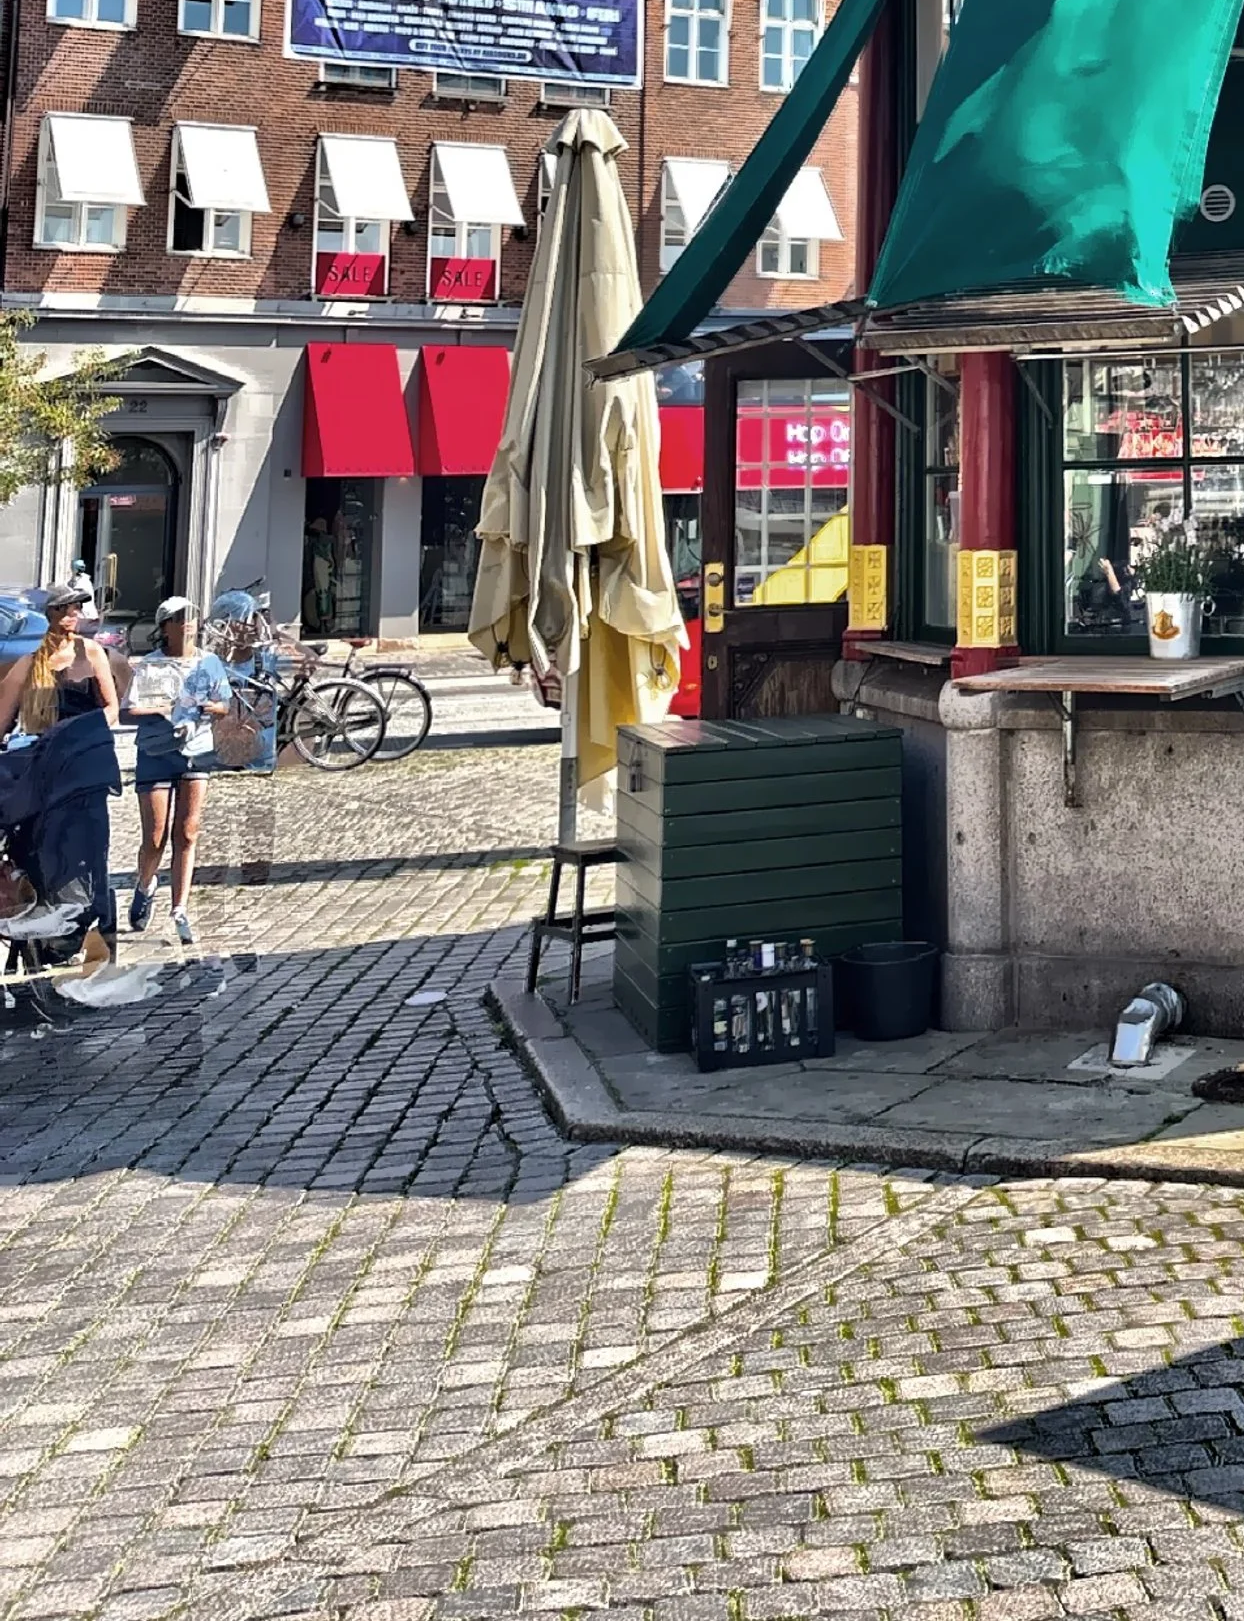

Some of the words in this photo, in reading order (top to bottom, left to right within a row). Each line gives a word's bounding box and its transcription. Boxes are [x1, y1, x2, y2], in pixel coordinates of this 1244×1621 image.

[328, 264, 371, 282] SALE
[442, 270, 482, 287] SALE
[128, 400, 148, 413] 22
